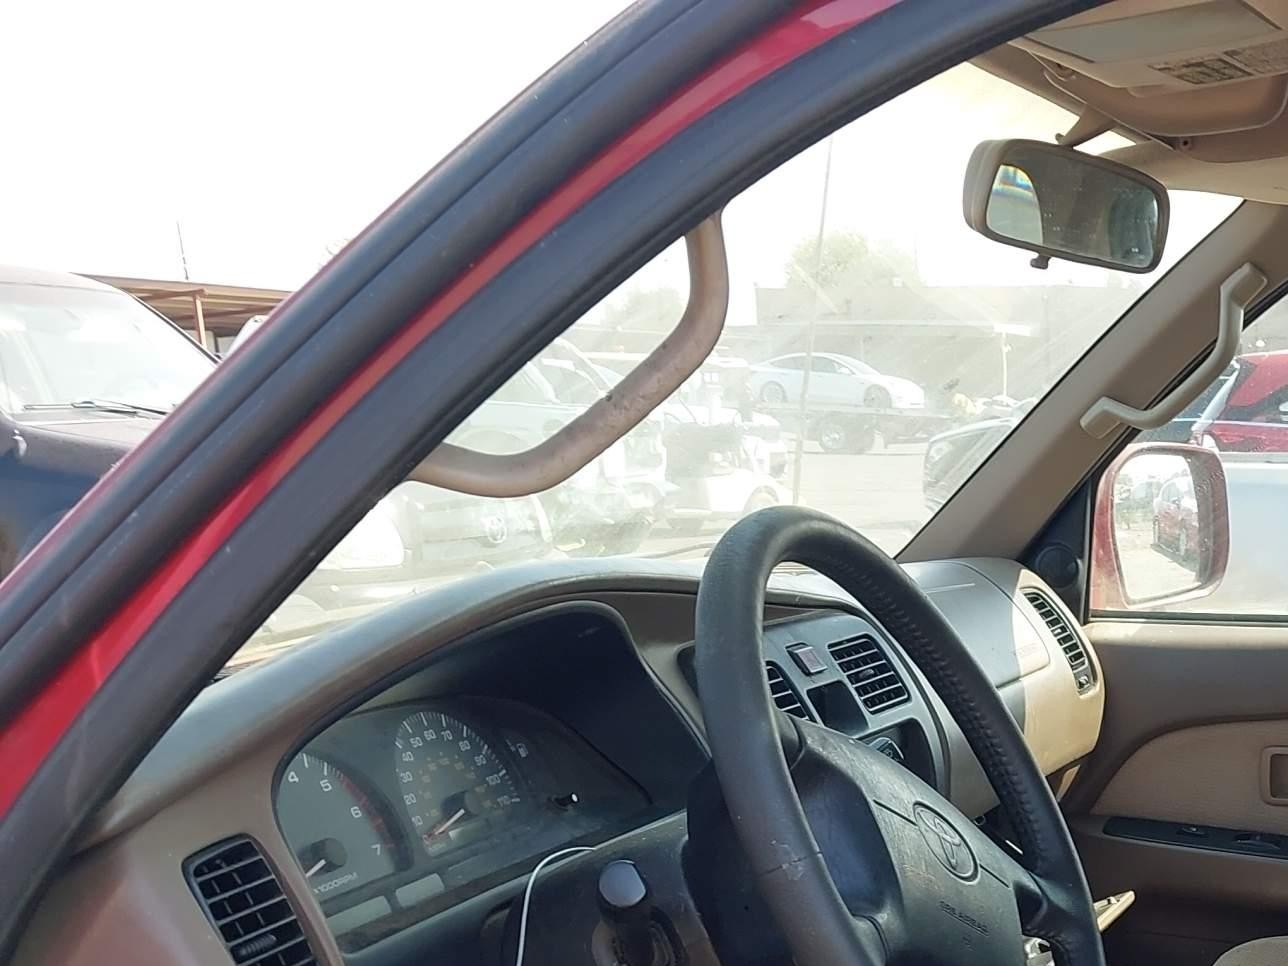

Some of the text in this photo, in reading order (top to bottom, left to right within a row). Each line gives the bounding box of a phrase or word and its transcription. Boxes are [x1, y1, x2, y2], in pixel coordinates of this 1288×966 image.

[423, 729, 437, 741] 60
[441, 730, 453, 742] 70
[409, 737, 424, 749] 50
[287, 771, 300, 784] 4
[400, 771, 413, 784] 30
[319, 779, 333, 792] 5
[403, 793, 417, 806] 20
[350, 806, 363, 819] 6
[411, 815, 424, 827] 10
[370, 844, 382, 856] 7
